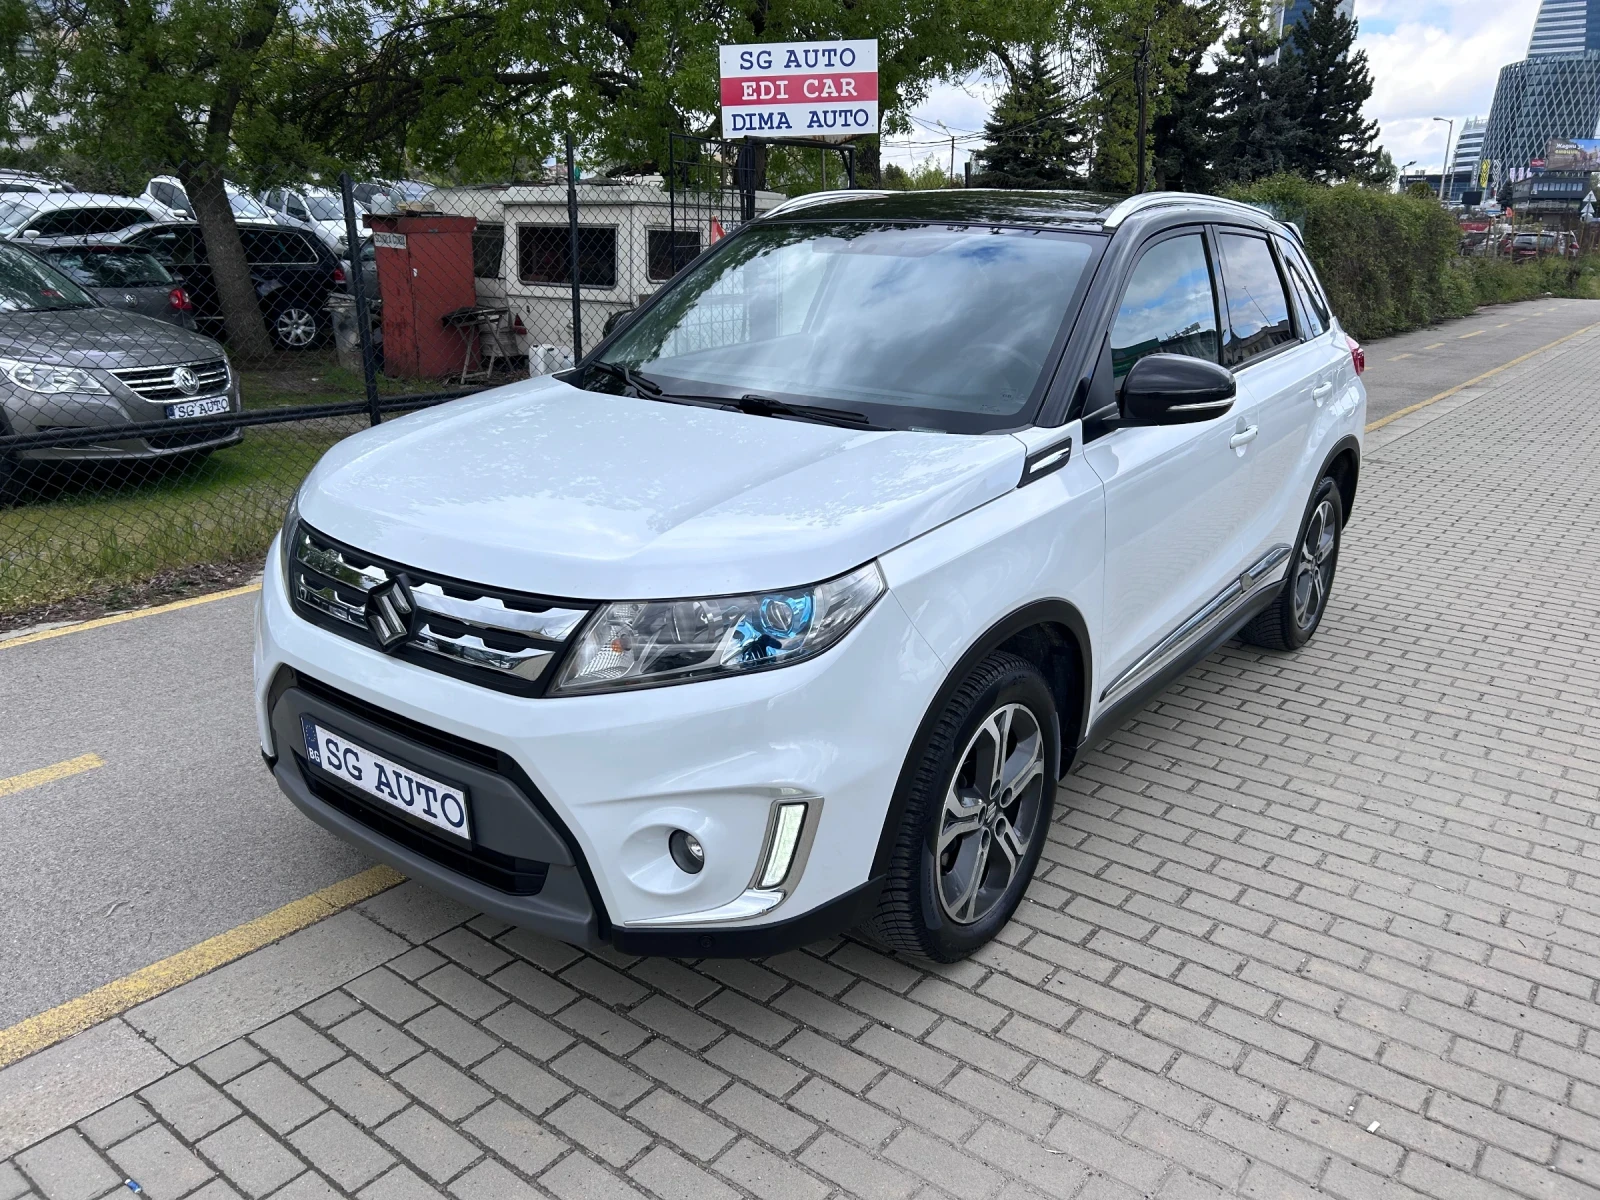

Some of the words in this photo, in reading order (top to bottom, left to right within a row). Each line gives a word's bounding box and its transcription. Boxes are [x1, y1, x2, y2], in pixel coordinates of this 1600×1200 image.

[739, 50, 773, 70] SG
[784, 48, 856, 69] AUTO
[741, 80, 789, 100] EDI
[803, 78, 858, 98] CAR
[731, 111, 792, 131] DIMA
[807, 108, 869, 129] AUTO
[178, 405, 195, 418] SG
[199, 398, 229, 415] AUTO
[308, 747, 321, 763] BG
[325, 738, 363, 781] SG
[373, 761, 465, 828] AUTO
